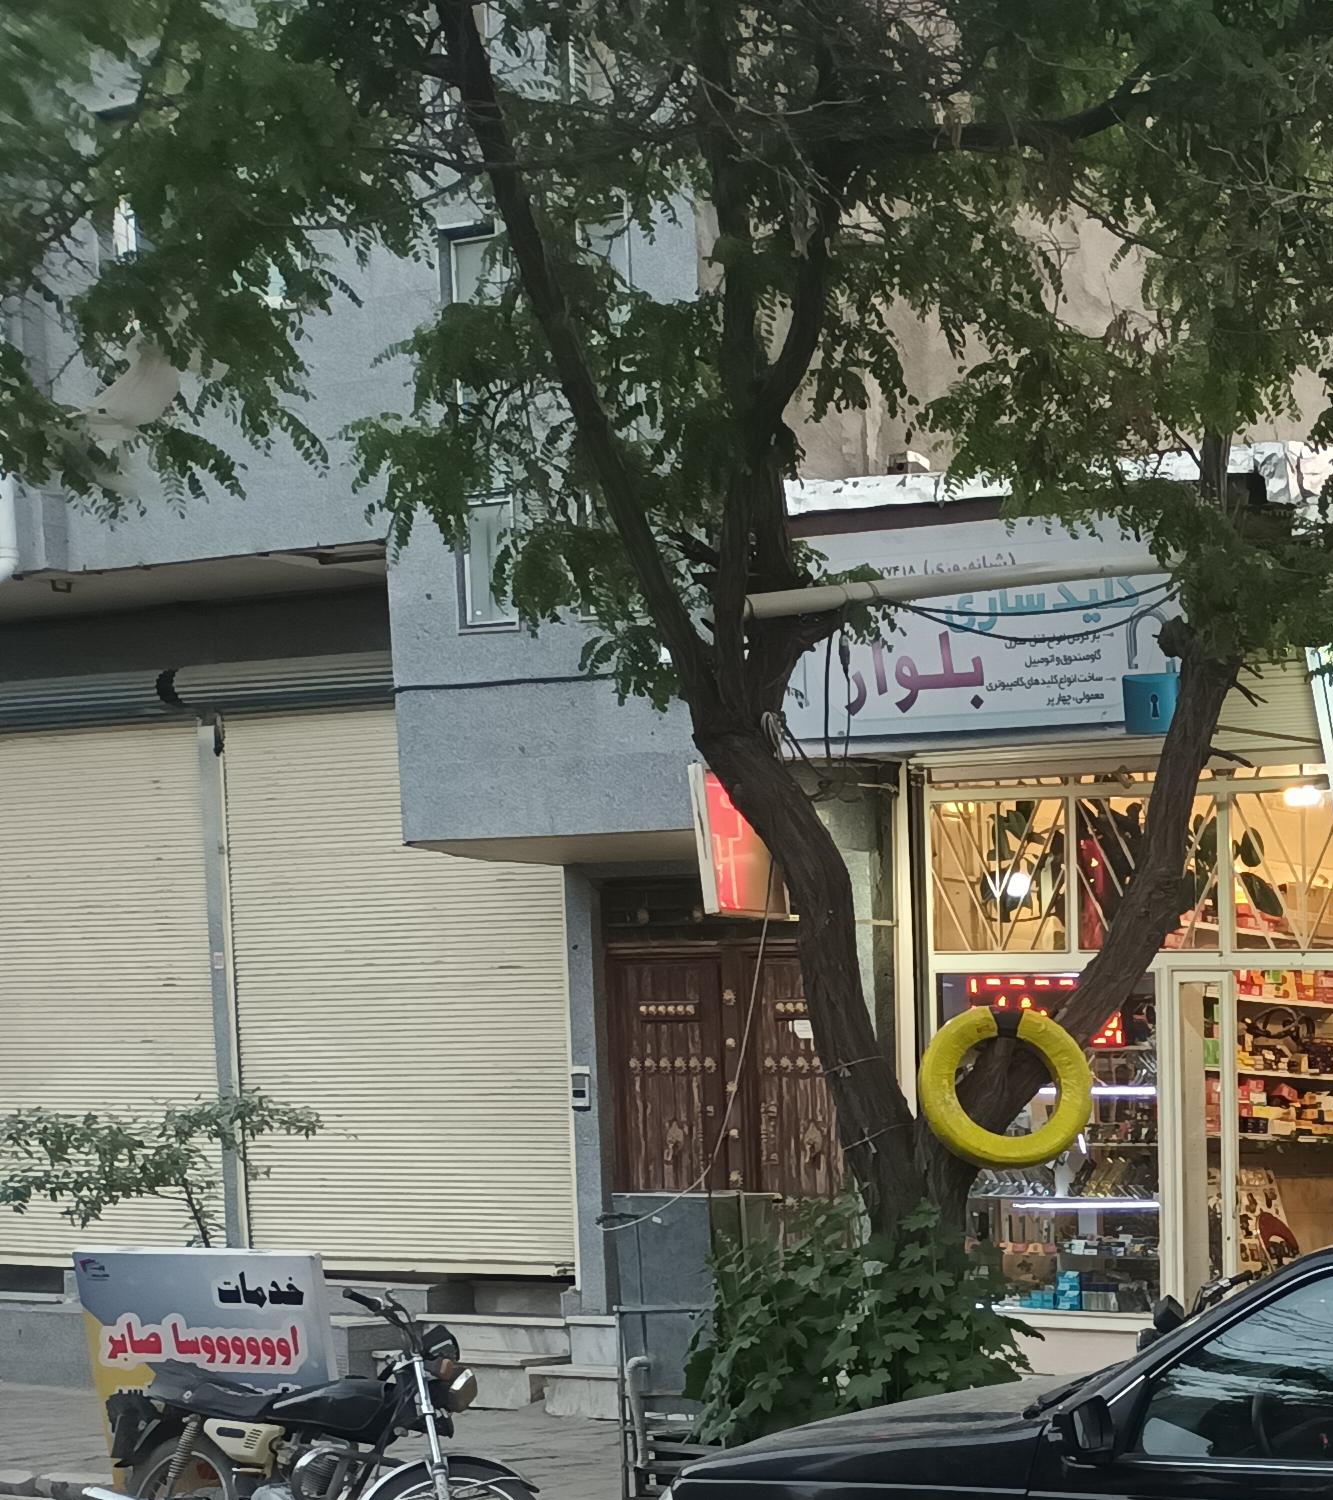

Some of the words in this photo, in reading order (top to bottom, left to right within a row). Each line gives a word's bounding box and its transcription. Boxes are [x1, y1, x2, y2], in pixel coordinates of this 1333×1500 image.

[845, 630, 985, 717] بلوار
[217, 1271, 305, 1309] خدمات
[107, 1321, 163, 1362] صابر
